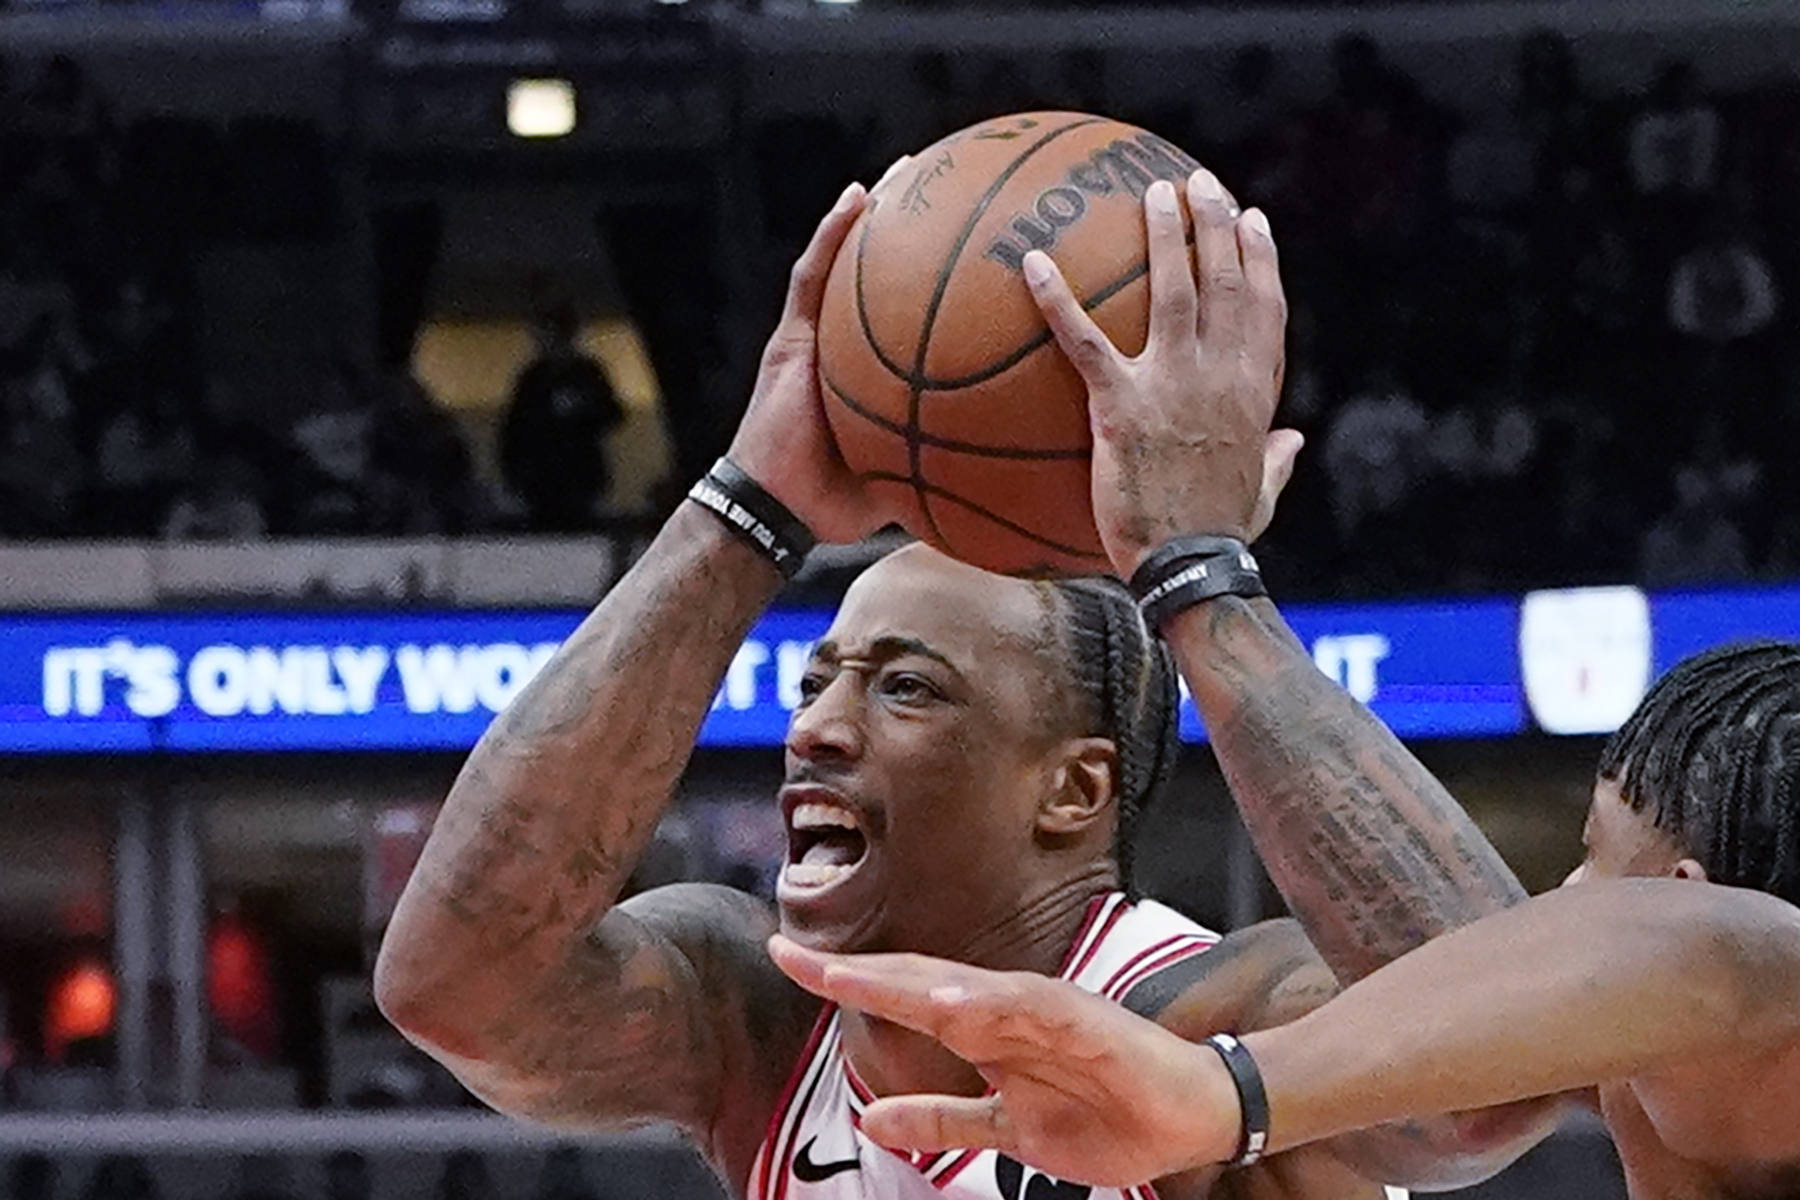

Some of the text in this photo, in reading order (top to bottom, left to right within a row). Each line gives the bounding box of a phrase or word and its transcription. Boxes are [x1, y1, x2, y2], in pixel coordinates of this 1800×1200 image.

[42, 638, 182, 717] IT'S
[188, 643, 392, 717] ONLY
[396, 641, 560, 715] WO
